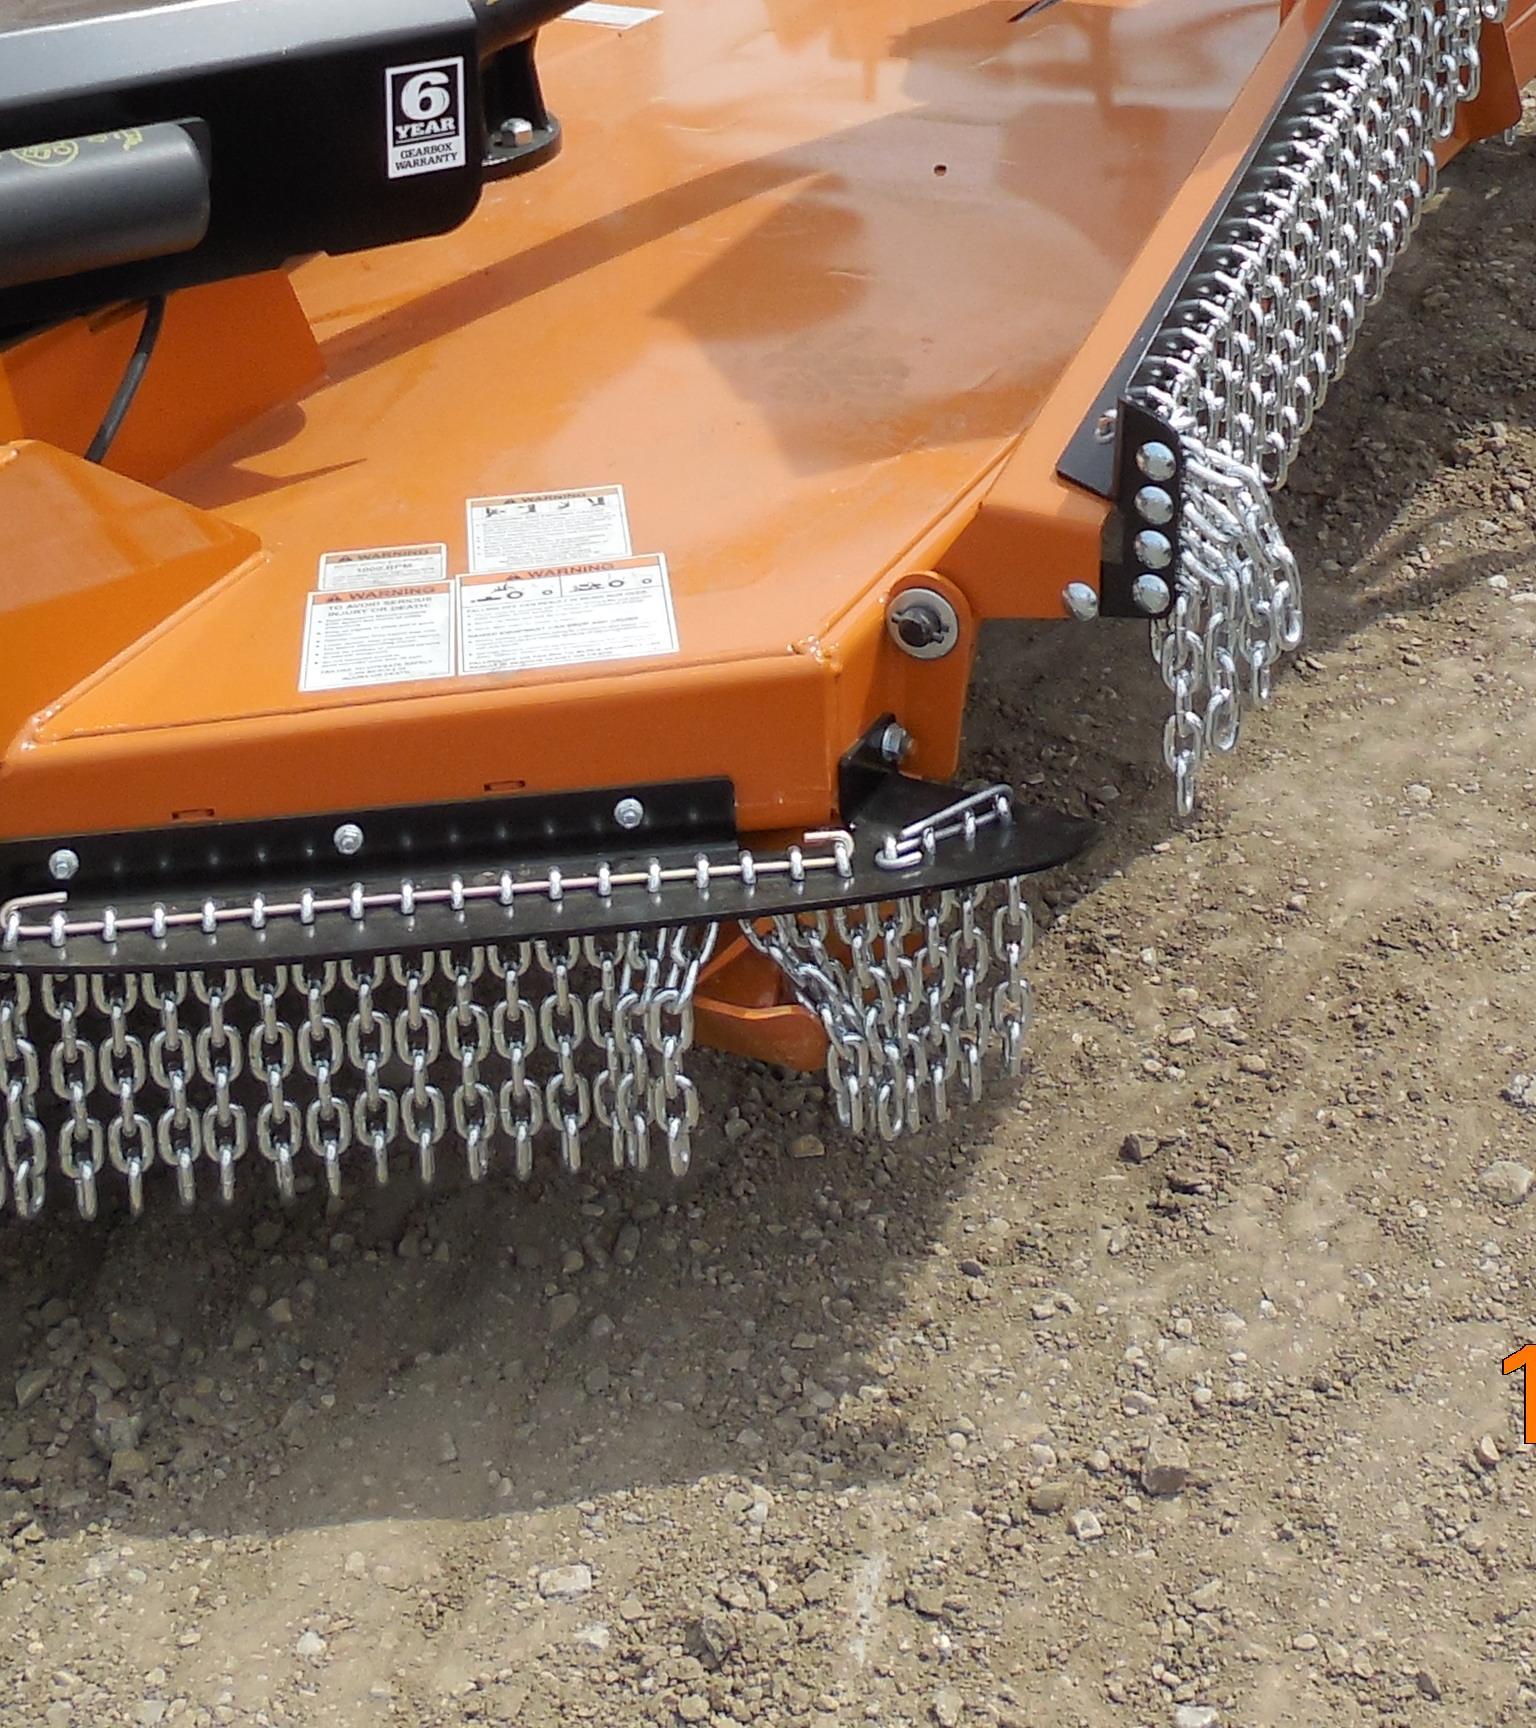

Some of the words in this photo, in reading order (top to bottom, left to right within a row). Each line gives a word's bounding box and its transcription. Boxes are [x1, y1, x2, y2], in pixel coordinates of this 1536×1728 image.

[400, 71, 451, 121] 6
[395, 117, 456, 140] YEAR
[400, 142, 453, 160] GEARBOX
[395, 152, 459, 171] WARRANTY
[521, 492, 587, 503] WARNING
[357, 549, 430, 561] WARNING
[527, 562, 616, 578] WARNING
[349, 586, 436, 601] WARNING
[327, 609, 368, 617] INJURY
[390, 603, 431, 612] DEATH
[345, 601, 381, 609] AVOID
[383, 597, 433, 606] SERIOUS
